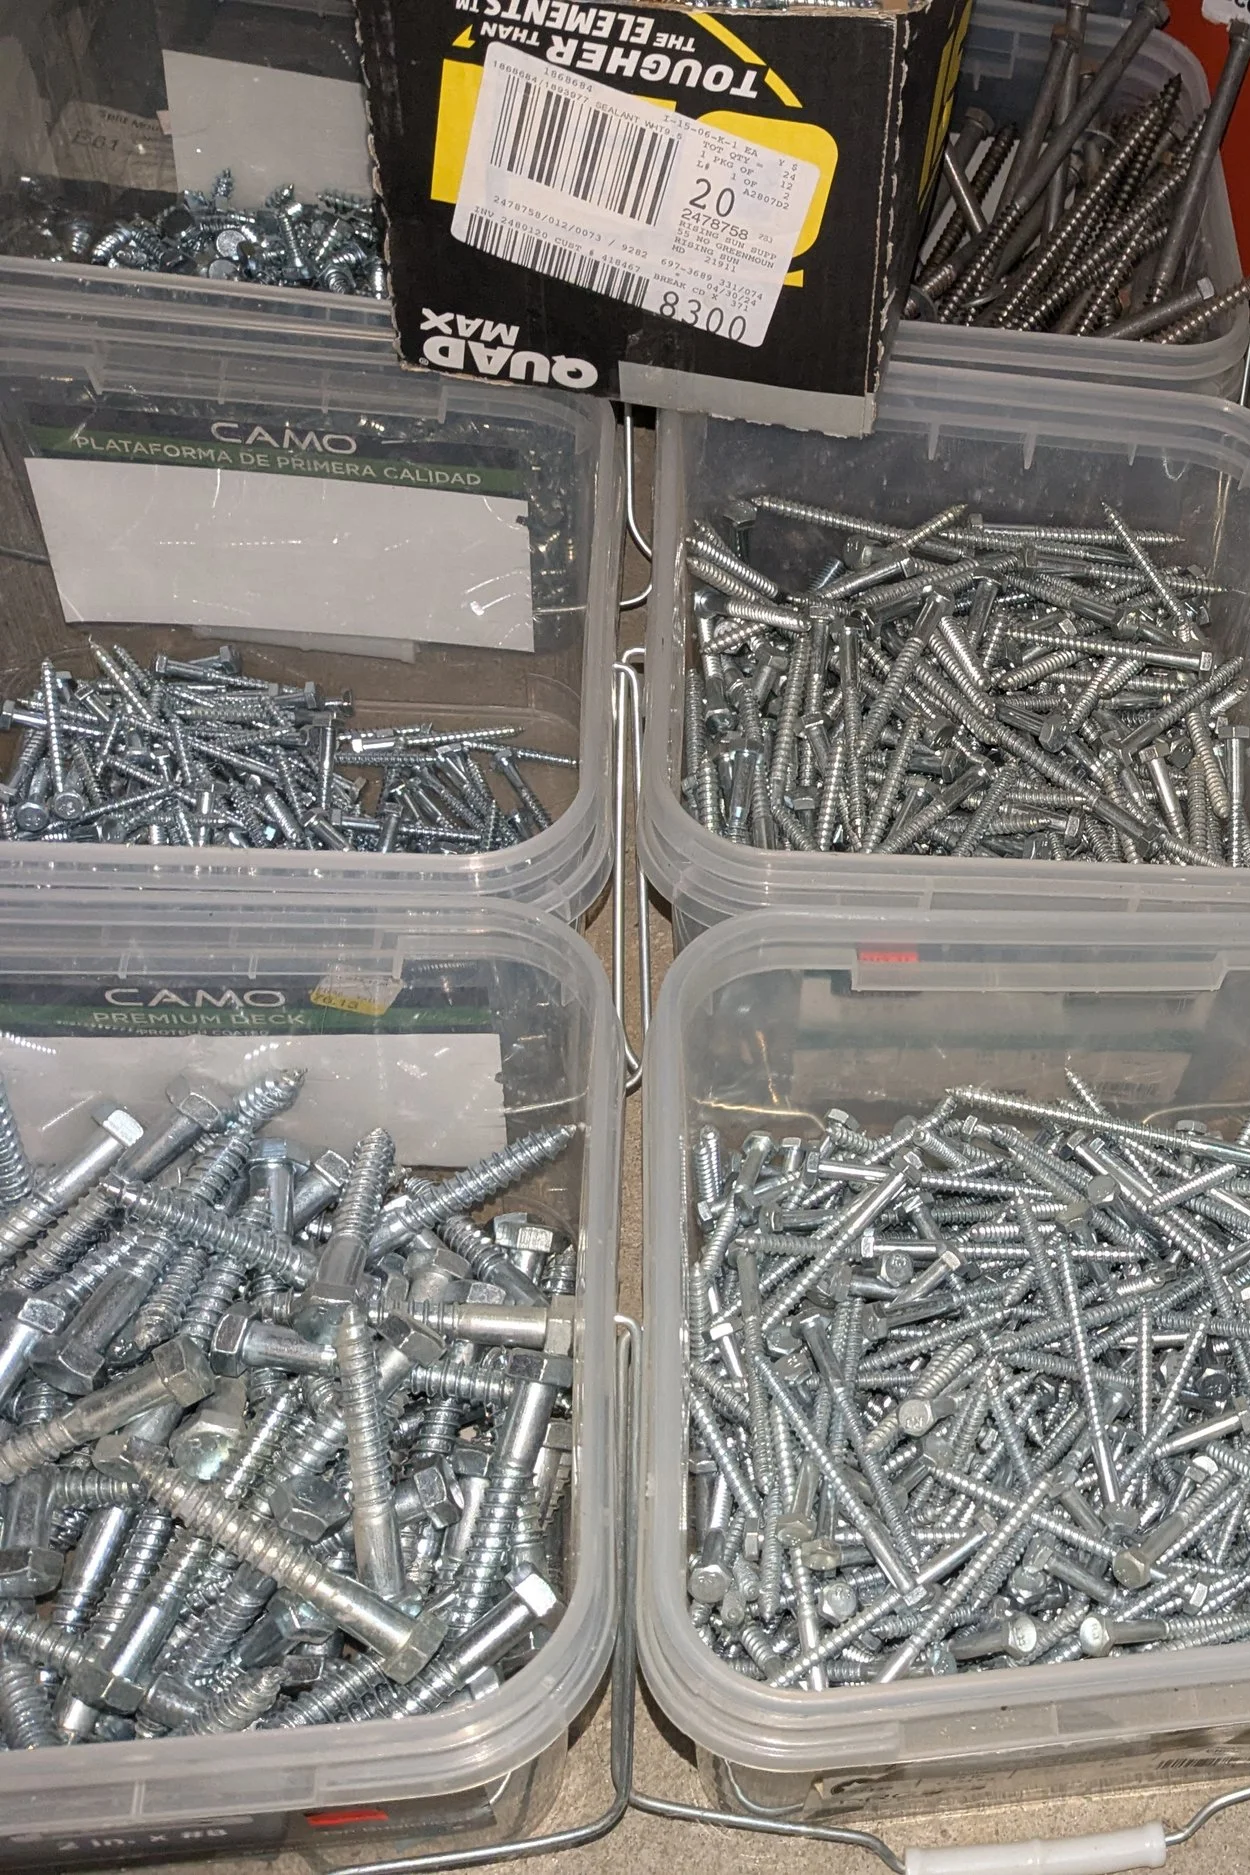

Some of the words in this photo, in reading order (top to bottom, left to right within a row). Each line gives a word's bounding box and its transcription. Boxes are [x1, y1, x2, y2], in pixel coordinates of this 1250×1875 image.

[480, 21, 541, 47] THAN
[654, 33, 696, 52] THE
[543, 67, 594, 93] 1868684
[546, 35, 758, 99] TOUGHER
[595, 101, 640, 123] SEALANT
[702, 140, 724, 155] TOT
[729, 151, 751, 164] QTY
[783, 171, 797, 181] 24
[713, 156, 734, 169] PKG
[740, 166, 755, 176] OF
[780, 180, 793, 191] 12
[689, 178, 736, 217] 20
[743, 178, 758, 188] OF
[681, 208, 749, 241] 2478758
[473, 206, 495, 218] INV
[554, 237, 582, 252] CUST
[601, 253, 641, 273] 418467
[621, 243, 648, 259] 9282
[674, 236, 714, 256] RISING
[677, 228, 690, 238] 55
[715, 242, 775, 269] GREENMOUN
[679, 220, 719, 240] RISING
[724, 237, 745, 249] SUN
[750, 247, 777, 260] SUPP
[661, 258, 713, 281] 697-3689
[704, 256, 737, 273] 21911
[653, 273, 687, 290] BREAK
[692, 287, 706, 296] CD
[420, 307, 520, 347] MAX
[660, 291, 747, 341] 8300
[211, 420, 357, 455] CAMO
[76, 436, 233, 466] PLATAFORMA
[239, 449, 270, 468] DE
[277, 455, 377, 479] PRIMERA
[383, 465, 481, 487] CALIDAD
[105, 988, 287, 1008] CAMO
[93, 1012, 222, 1026] PREMIUM
[231, 1013, 306, 1026] DECK
